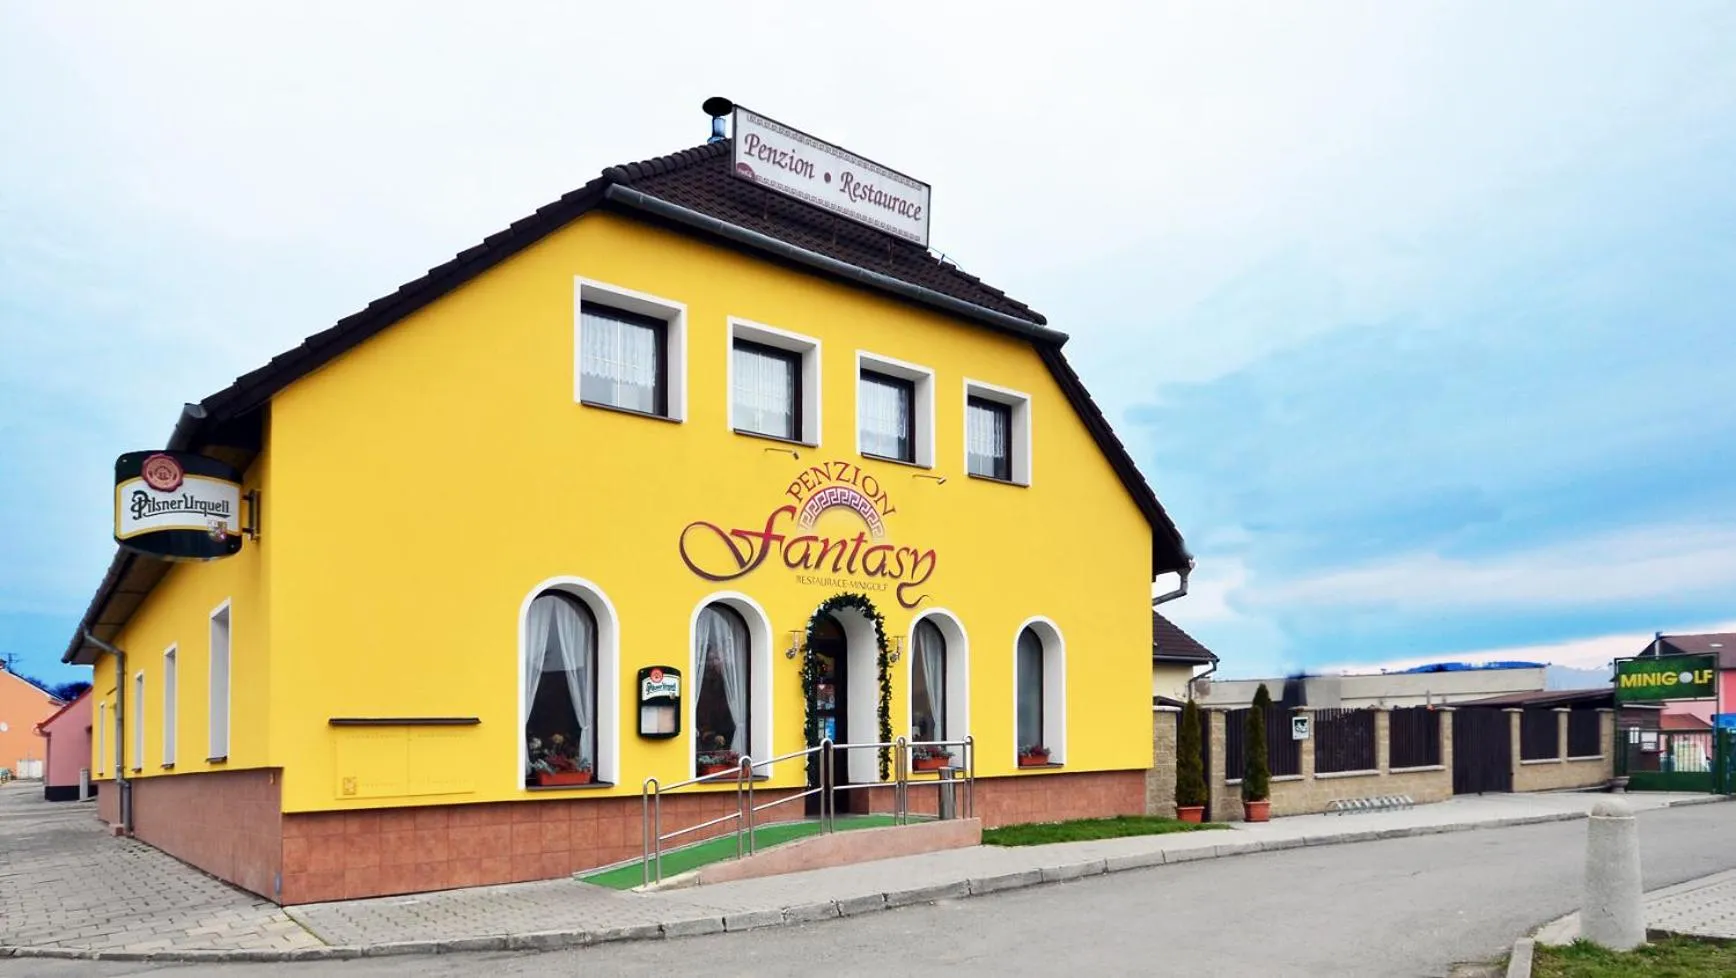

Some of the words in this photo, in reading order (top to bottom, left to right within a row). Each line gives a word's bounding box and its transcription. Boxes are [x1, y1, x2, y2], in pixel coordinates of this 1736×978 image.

[743, 133, 815, 180] Penzion
[839, 171, 922, 221] Restaurace
[130, 490, 184, 520] Pilsner
[182, 493, 230, 517] Urquell
[785, 461, 896, 516] PENZION
[1620, 669, 1713, 687] MINIGOLF
